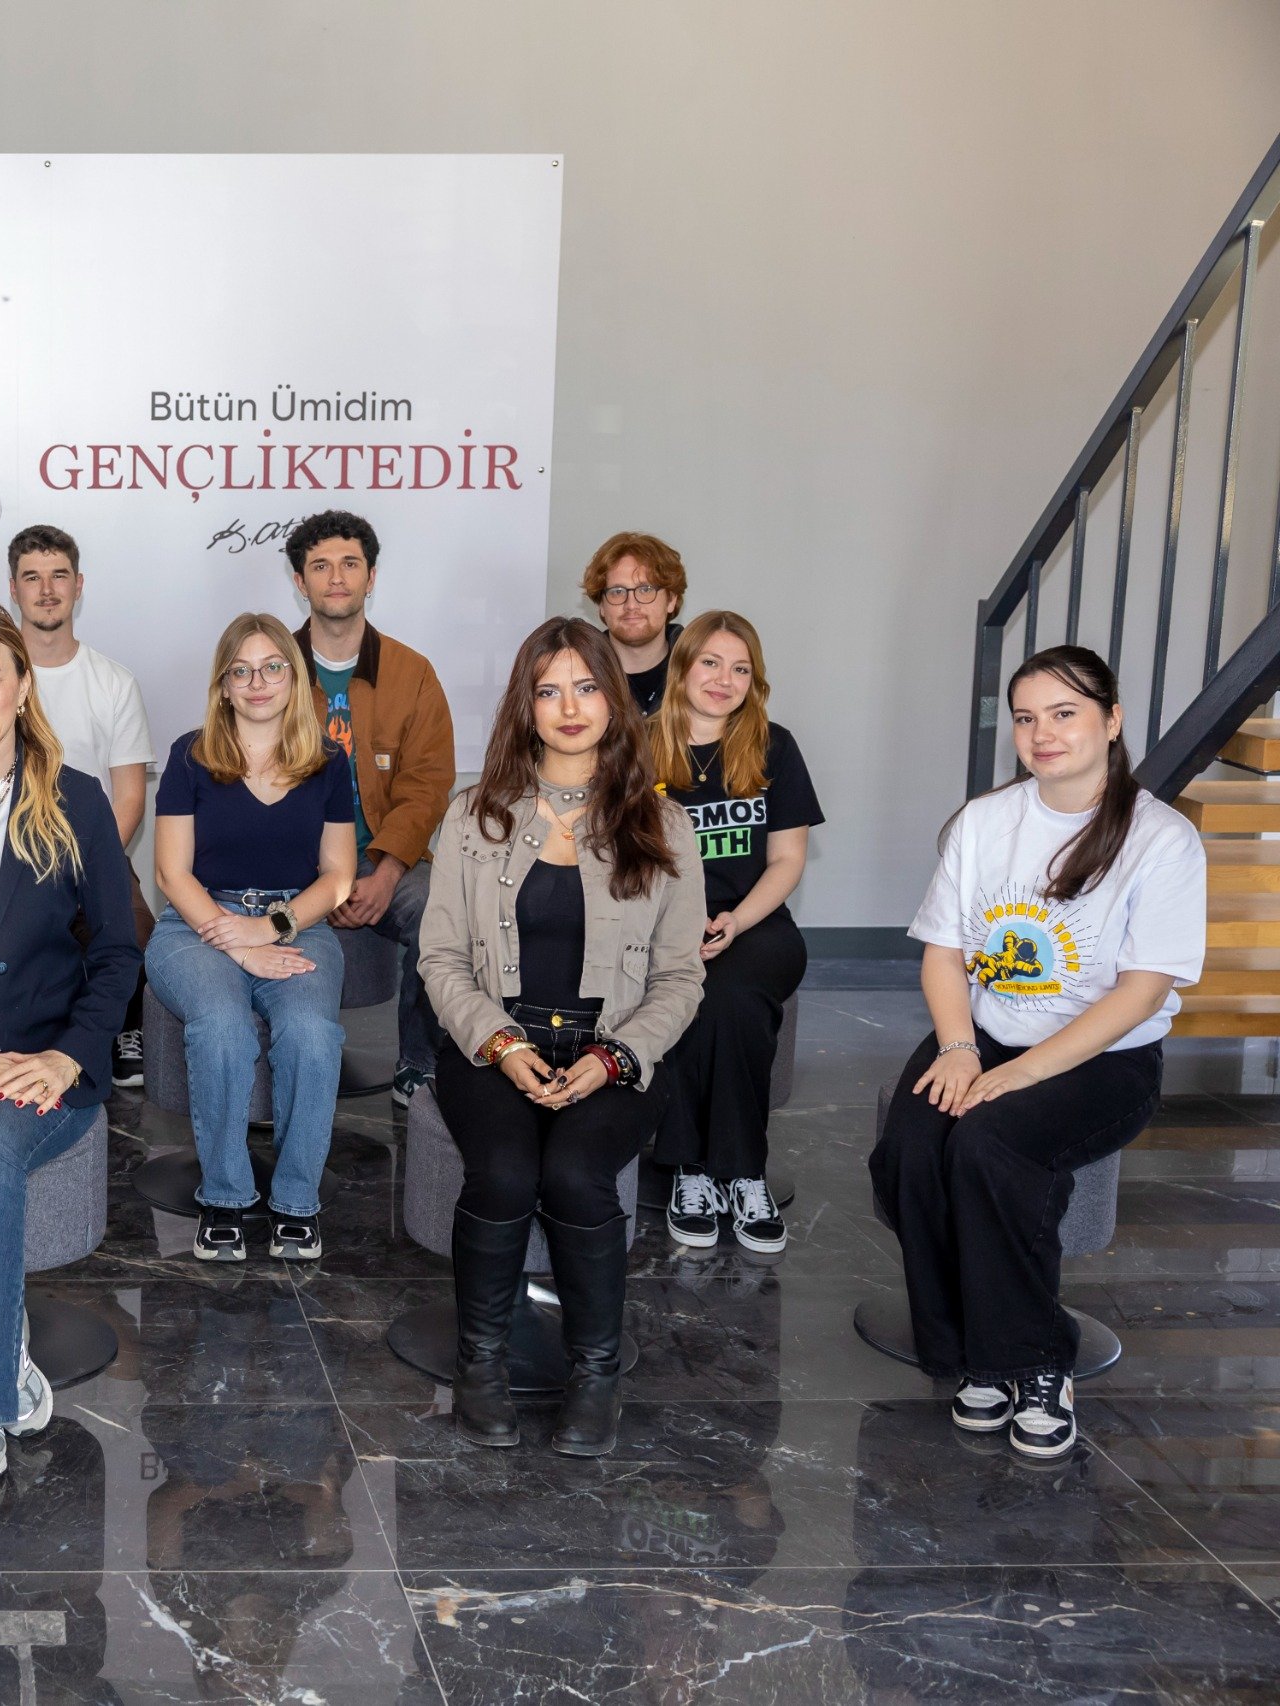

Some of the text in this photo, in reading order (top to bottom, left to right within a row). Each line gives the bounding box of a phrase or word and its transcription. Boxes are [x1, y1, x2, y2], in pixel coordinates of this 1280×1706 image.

[150, 384, 412, 422] Bütün Ümidim
[38, 428, 523, 503] GENÇLİKTEDİR
[686, 799, 765, 829] SMOS
